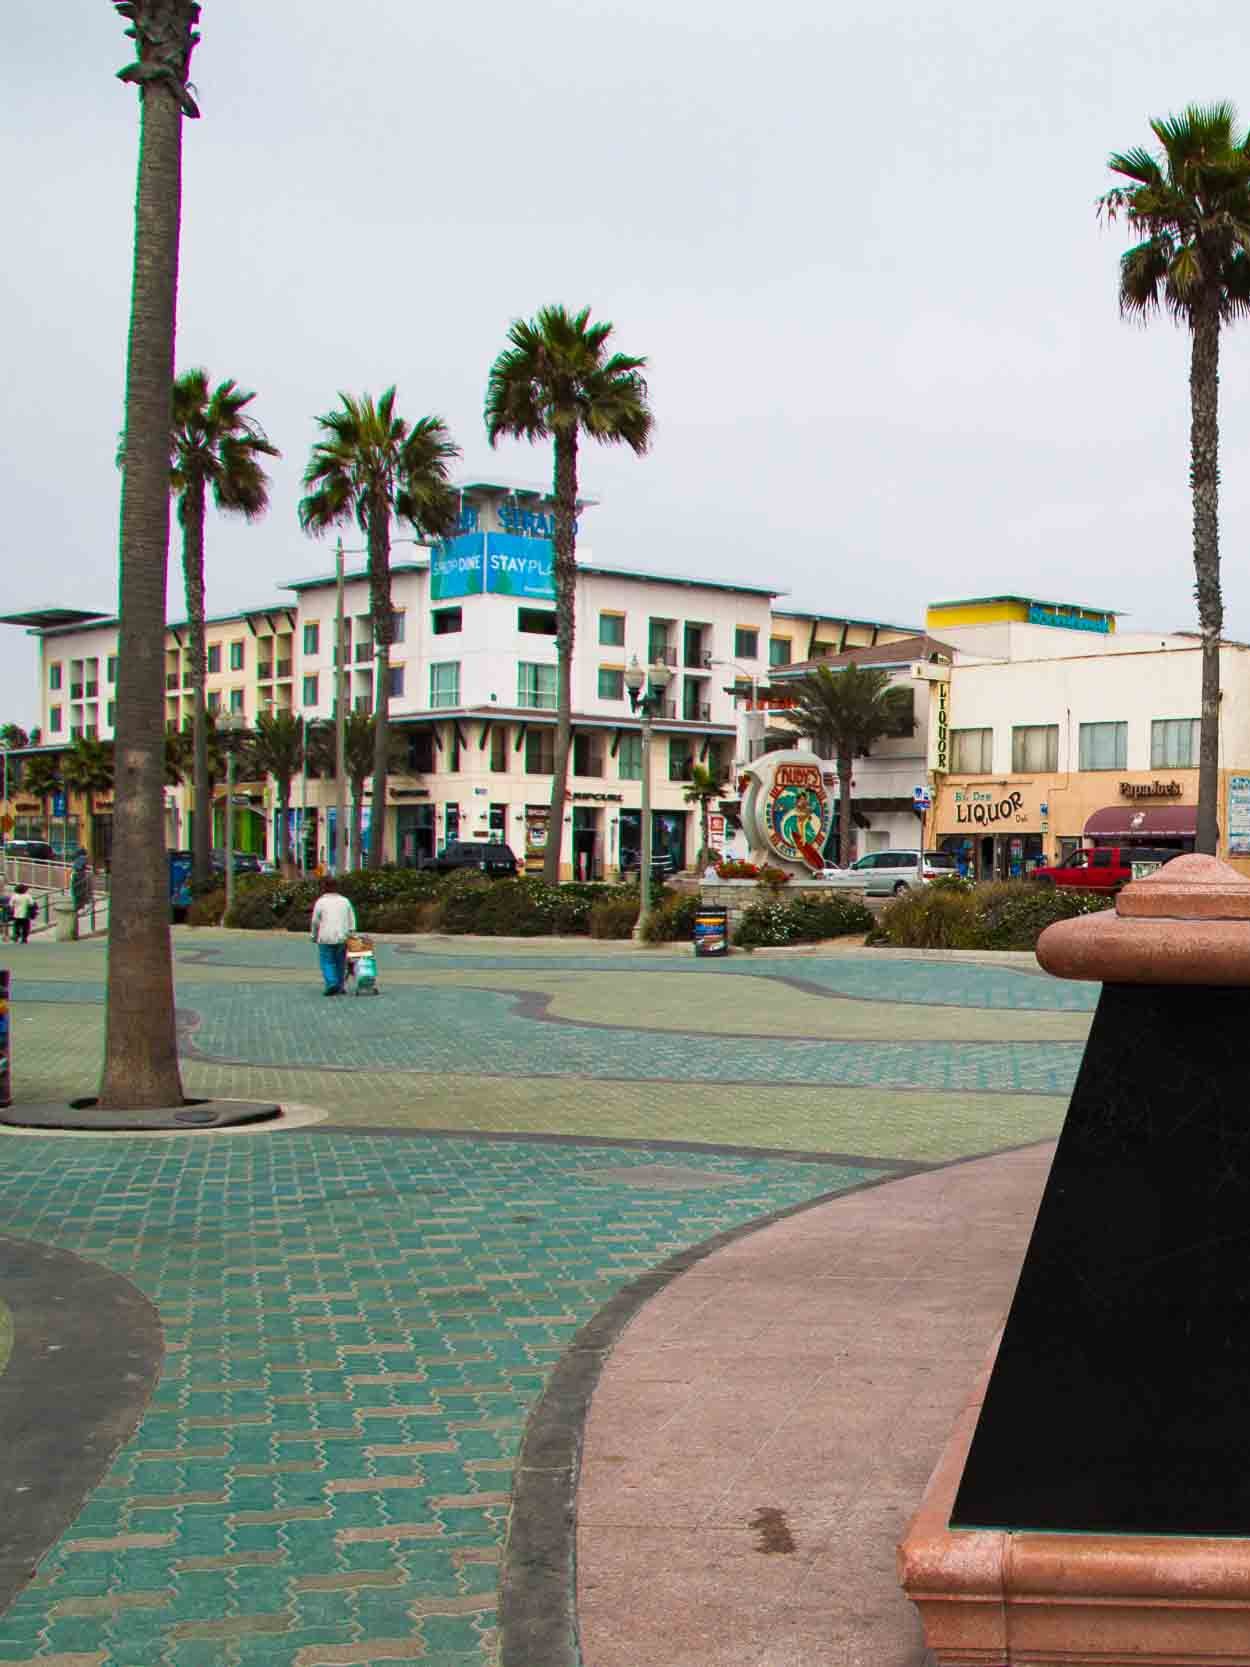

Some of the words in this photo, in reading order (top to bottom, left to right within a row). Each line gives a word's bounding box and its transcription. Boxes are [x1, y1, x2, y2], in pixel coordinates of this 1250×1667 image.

[458, 554, 481, 570] DINE
[490, 553, 527, 574] STAY
[938, 683, 948, 769] LIQUOR
[956, 791, 1024, 826] LIQUOR
